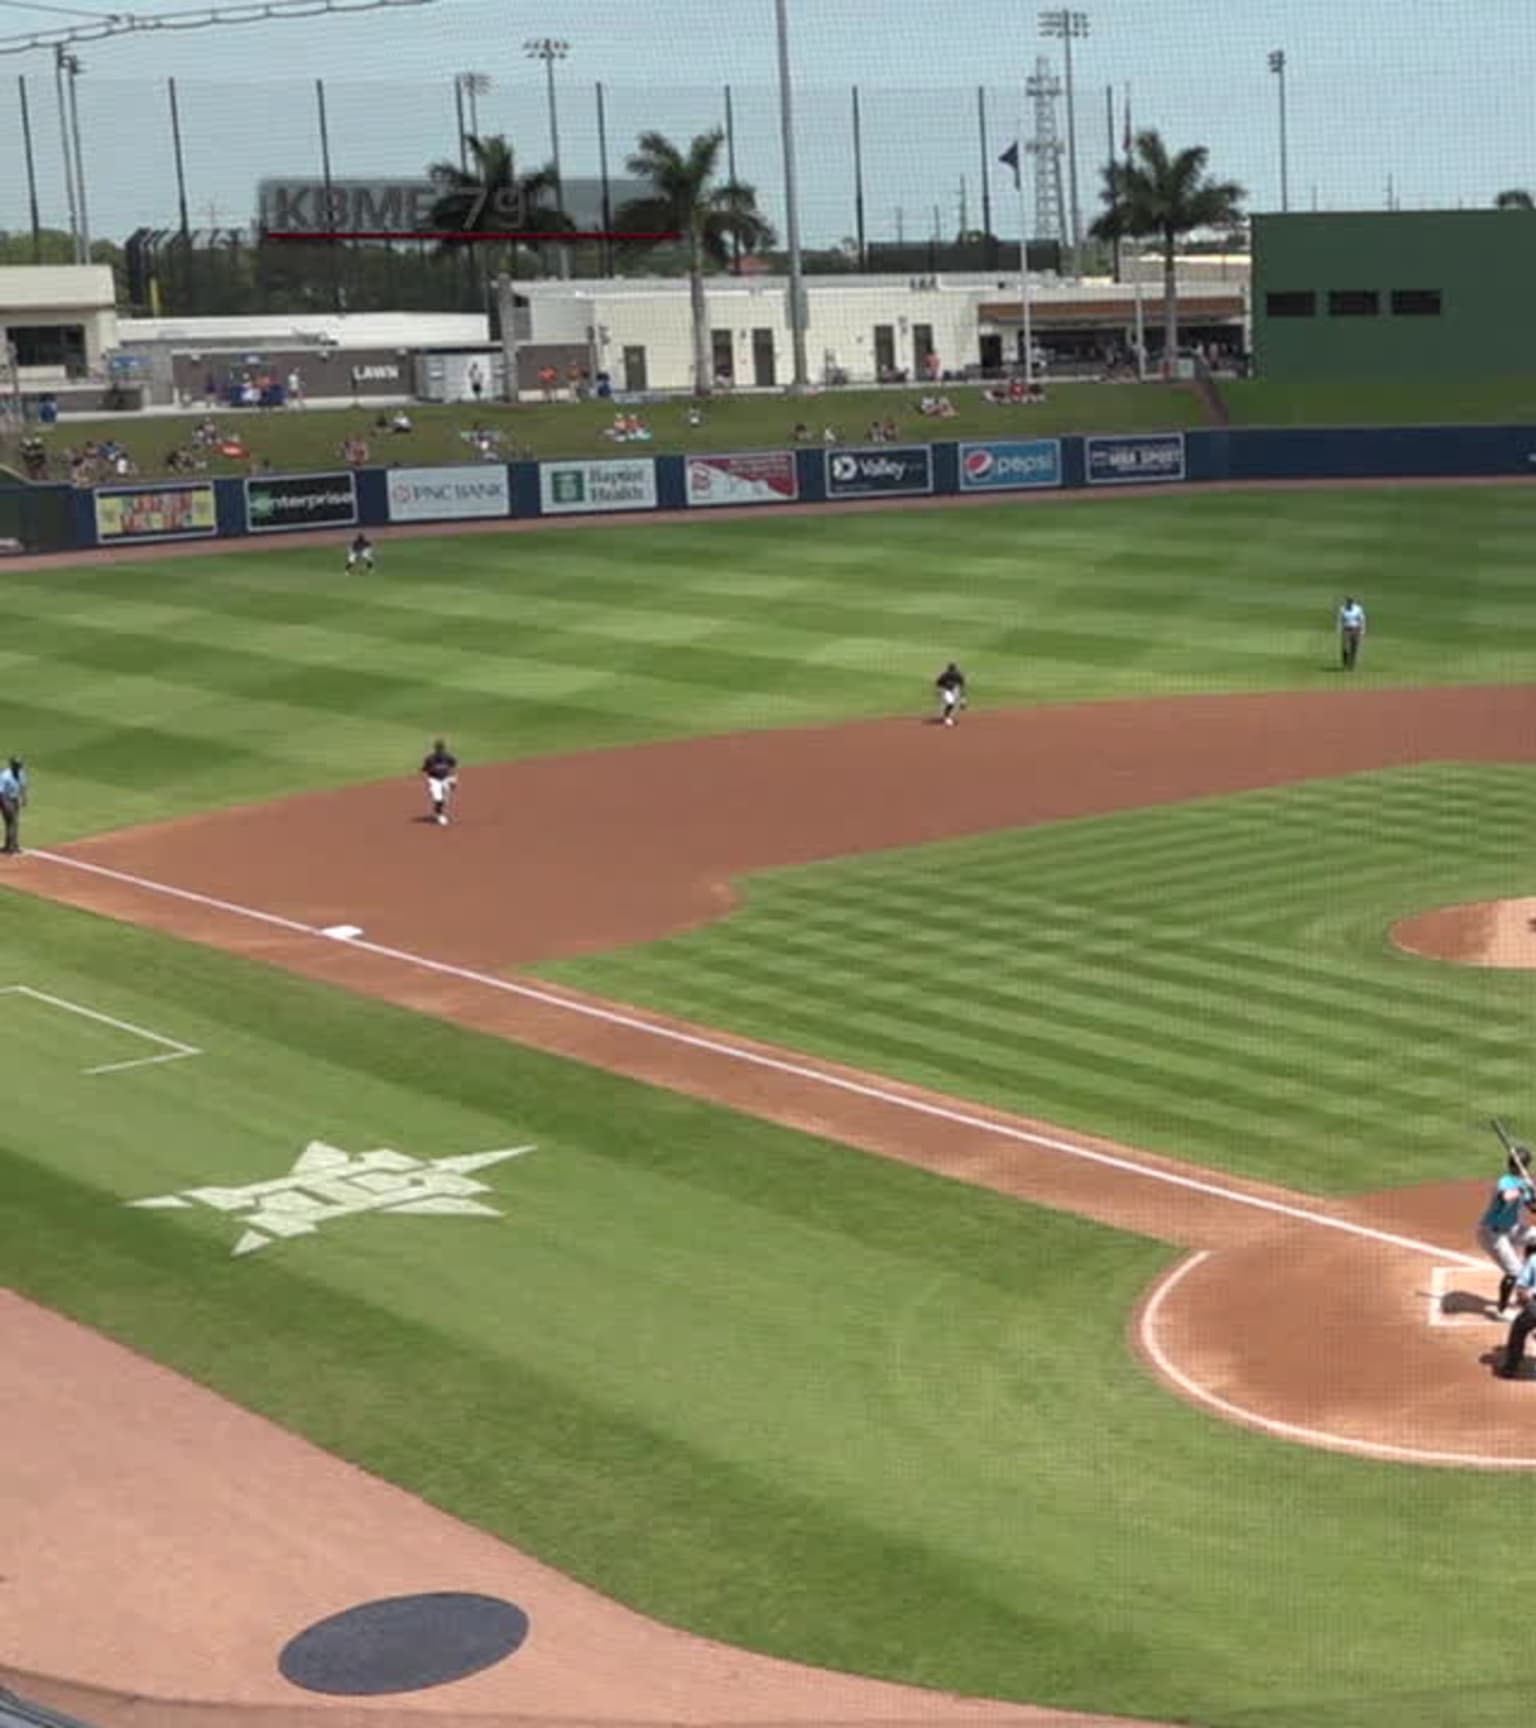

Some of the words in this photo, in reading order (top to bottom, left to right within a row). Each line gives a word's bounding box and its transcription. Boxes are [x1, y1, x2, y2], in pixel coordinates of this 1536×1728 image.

[351, 365, 399, 380] LAWN
[589, 464, 644, 484] Baptist
[858, 457, 906, 481] Valley
[998, 454, 1055, 475] pepsi
[590, 484, 644, 502] Health
